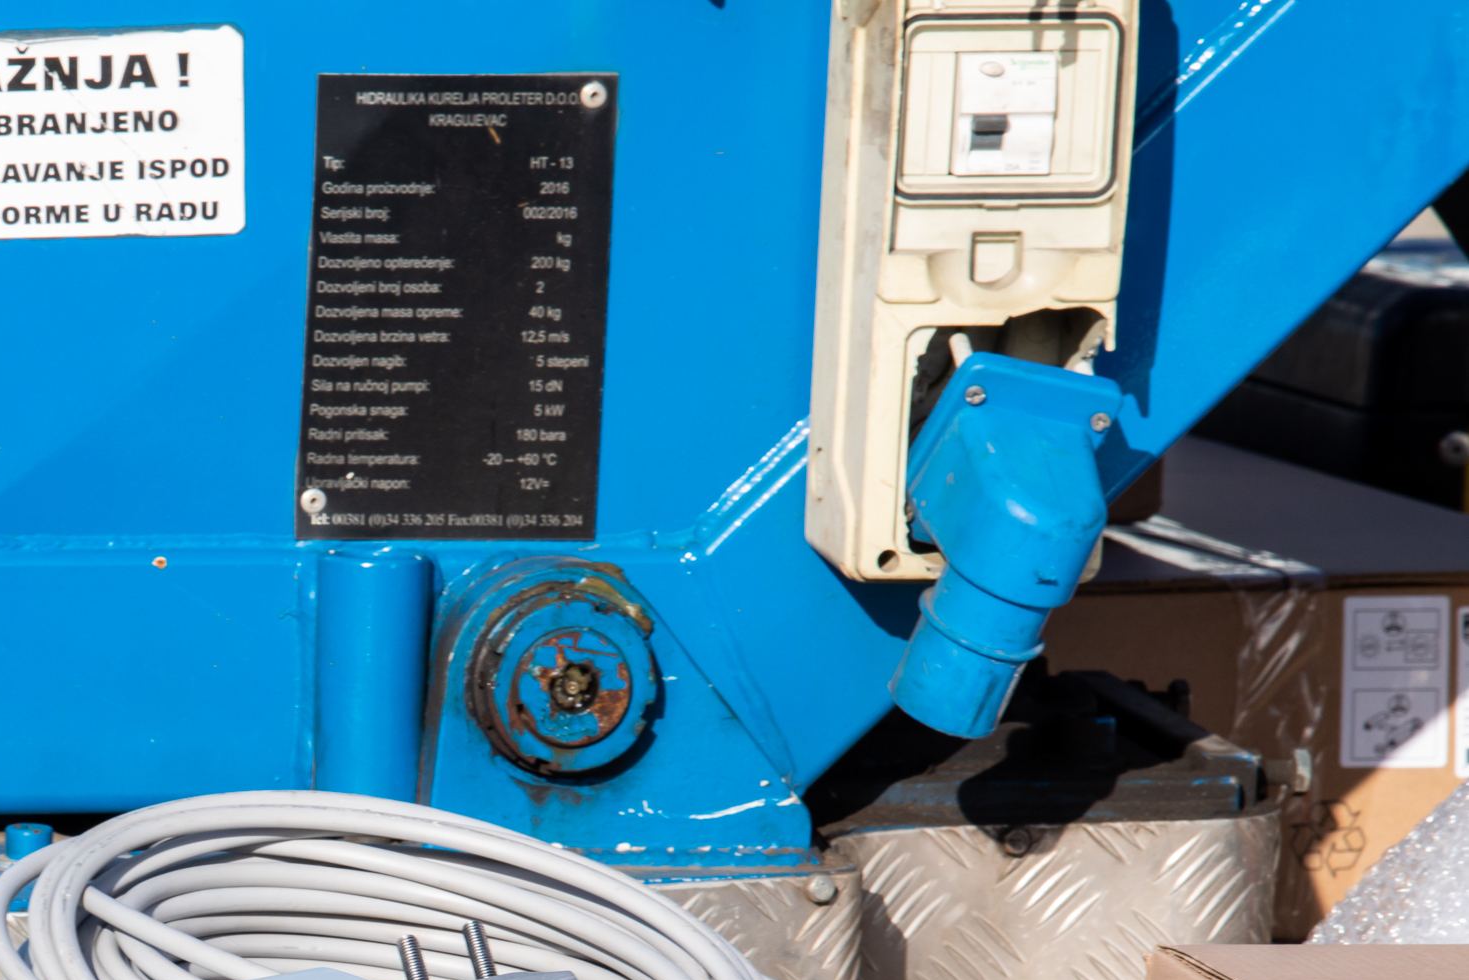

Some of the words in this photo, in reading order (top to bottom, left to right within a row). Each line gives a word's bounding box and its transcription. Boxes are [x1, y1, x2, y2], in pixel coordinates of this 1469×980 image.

[177, 53, 190, 88] !
[356, 92, 426, 105] HIDRAULIKA
[428, 92, 480, 105] KURELJA
[481, 92, 544, 105] PROLETER
[429, 114, 507, 127] KRAGUJEVAC
[138, 158, 230, 180] ISPOD
[530, 157, 548, 169] HT
[559, 157, 574, 169] 13
[322, 182, 363, 194] Godina
[366, 182, 436, 197] proizvodnje:
[540, 182, 569, 194] 2016
[104, 204, 121, 221] U
[135, 202, 219, 221] RADU
[321, 207, 362, 221] Serijski
[523, 207, 577, 220] 002/2016
[320, 231, 361, 244] Vlastita
[365, 233, 399, 244] masa:
[557, 232, 572, 246] kg
[318, 256, 381, 271] Dozvoljeno
[531, 257, 552, 269] 200
[555, 257, 570, 272] kg
[317, 281, 376, 296] Dozvoljeni
[378, 281, 400, 296] broj
[403, 281, 442, 294] osoba:
[536, 282, 544, 294] 2
[315, 306, 378, 320] Dozvoljena
[381, 307, 412, 318] masa
[416, 307, 463, 320] opreme:
[529, 306, 544, 318] 40
[547, 306, 561, 321] kg
[314, 330, 377, 345] Dozvoljena
[380, 330, 415, 343] brzina
[419, 331, 451, 343] vetra:
[548, 331, 570, 343] m/s
[313, 355, 369, 369] Dozvoljen
[372, 355, 407, 370] nagib:
[536, 356, 544, 367] 5
[547, 356, 589, 369] stepeni
[311, 379, 332, 392] Sila
[336, 381, 351, 392] na
[353, 379, 388, 394] ručnoj
[529, 380, 542, 393] 15
[545, 380, 563, 393] dN
[310, 404, 367, 419] Pogonska
[370, 406, 408, 419] snaga:
[534, 405, 542, 417] 5
[544, 404, 564, 417] kW
[309, 428, 342, 441] Radni
[517, 429, 537, 442] 180
[540, 429, 566, 442] bara
[307, 453, 344, 465] Radna
[348, 453, 420, 468] temperatura:
[371, 478, 410, 492] napon:
[332, 514, 365, 526] 00381
[368, 514, 399, 528] (0)34
[402, 514, 422, 526] 336
[425, 514, 445, 527] 205
[506, 514, 537, 528] (0)34
[540, 514, 561, 527] 336
[563, 514, 583, 527] 204
